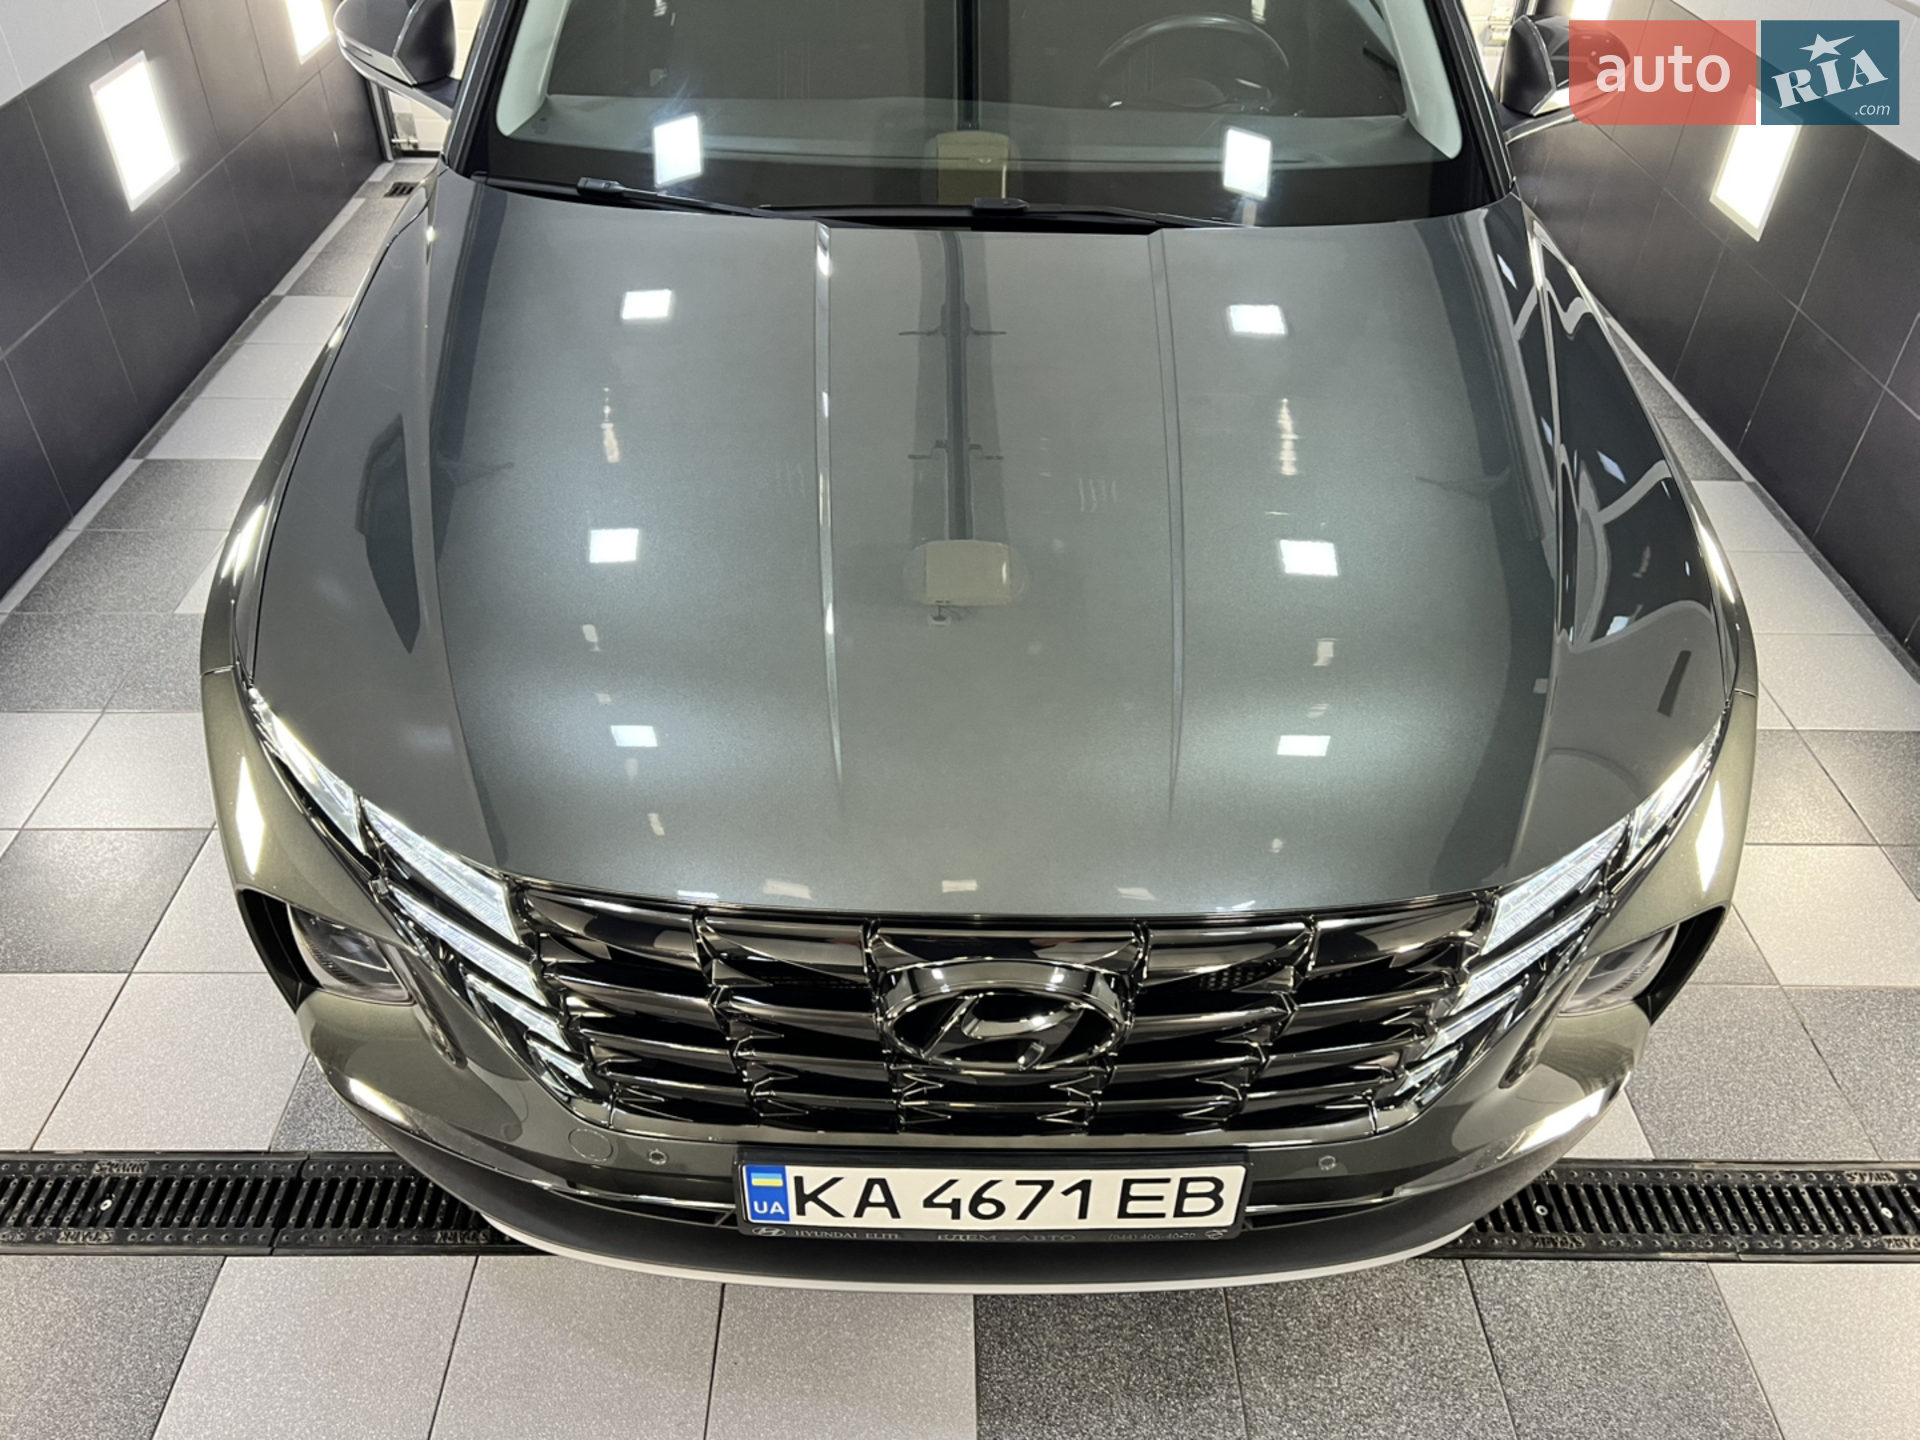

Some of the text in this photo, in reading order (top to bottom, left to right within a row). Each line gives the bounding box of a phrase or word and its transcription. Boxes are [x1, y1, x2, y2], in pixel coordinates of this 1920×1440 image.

[794, 1176, 1225, 1221] KA 4671 EB
[753, 1201, 785, 1215] UA
[794, 1229, 857, 1239] HYUNDAI
